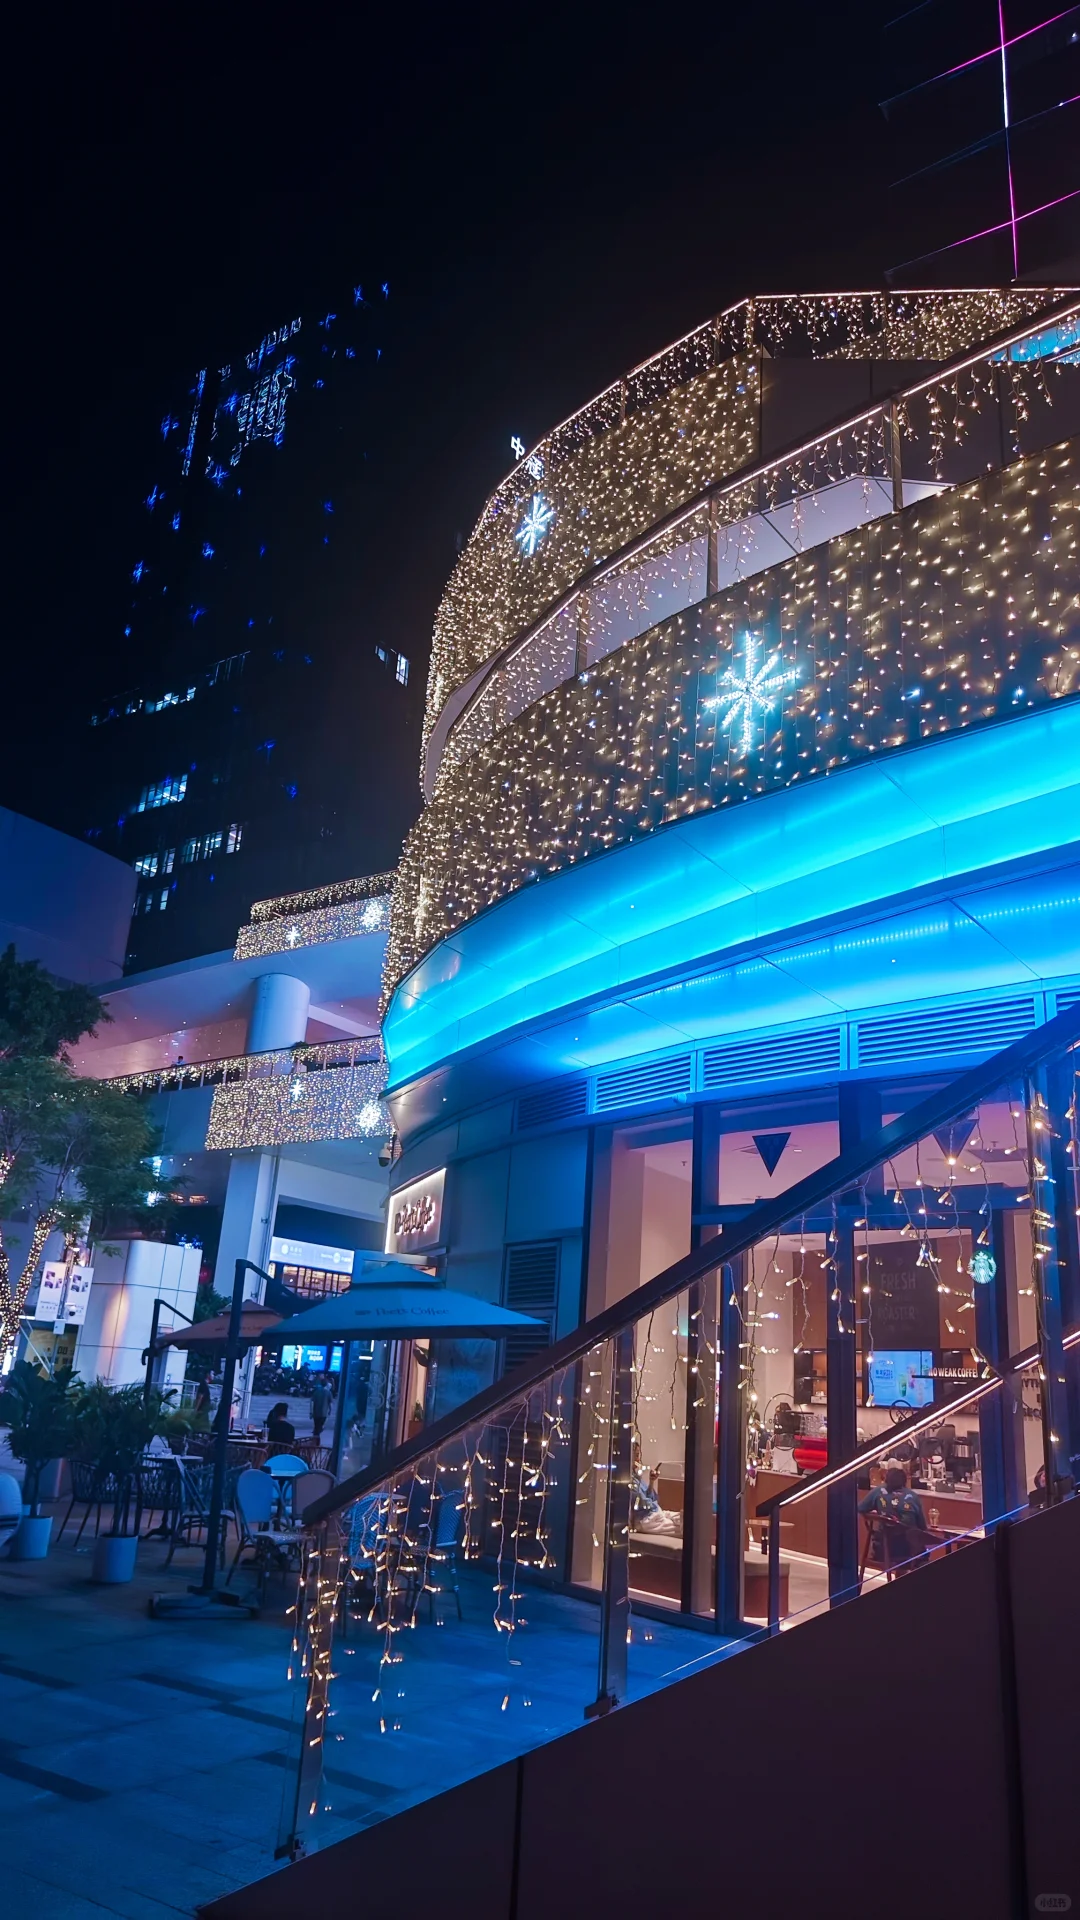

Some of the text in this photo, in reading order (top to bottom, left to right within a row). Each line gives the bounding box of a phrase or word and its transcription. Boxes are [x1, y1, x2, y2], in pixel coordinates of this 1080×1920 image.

[881, 1271, 916, 1290] FRESH
[411, 1307, 450, 1316] Coffee
[938, 1367, 957, 1378] WEAK
[957, 1367, 979, 1379] COFFE
